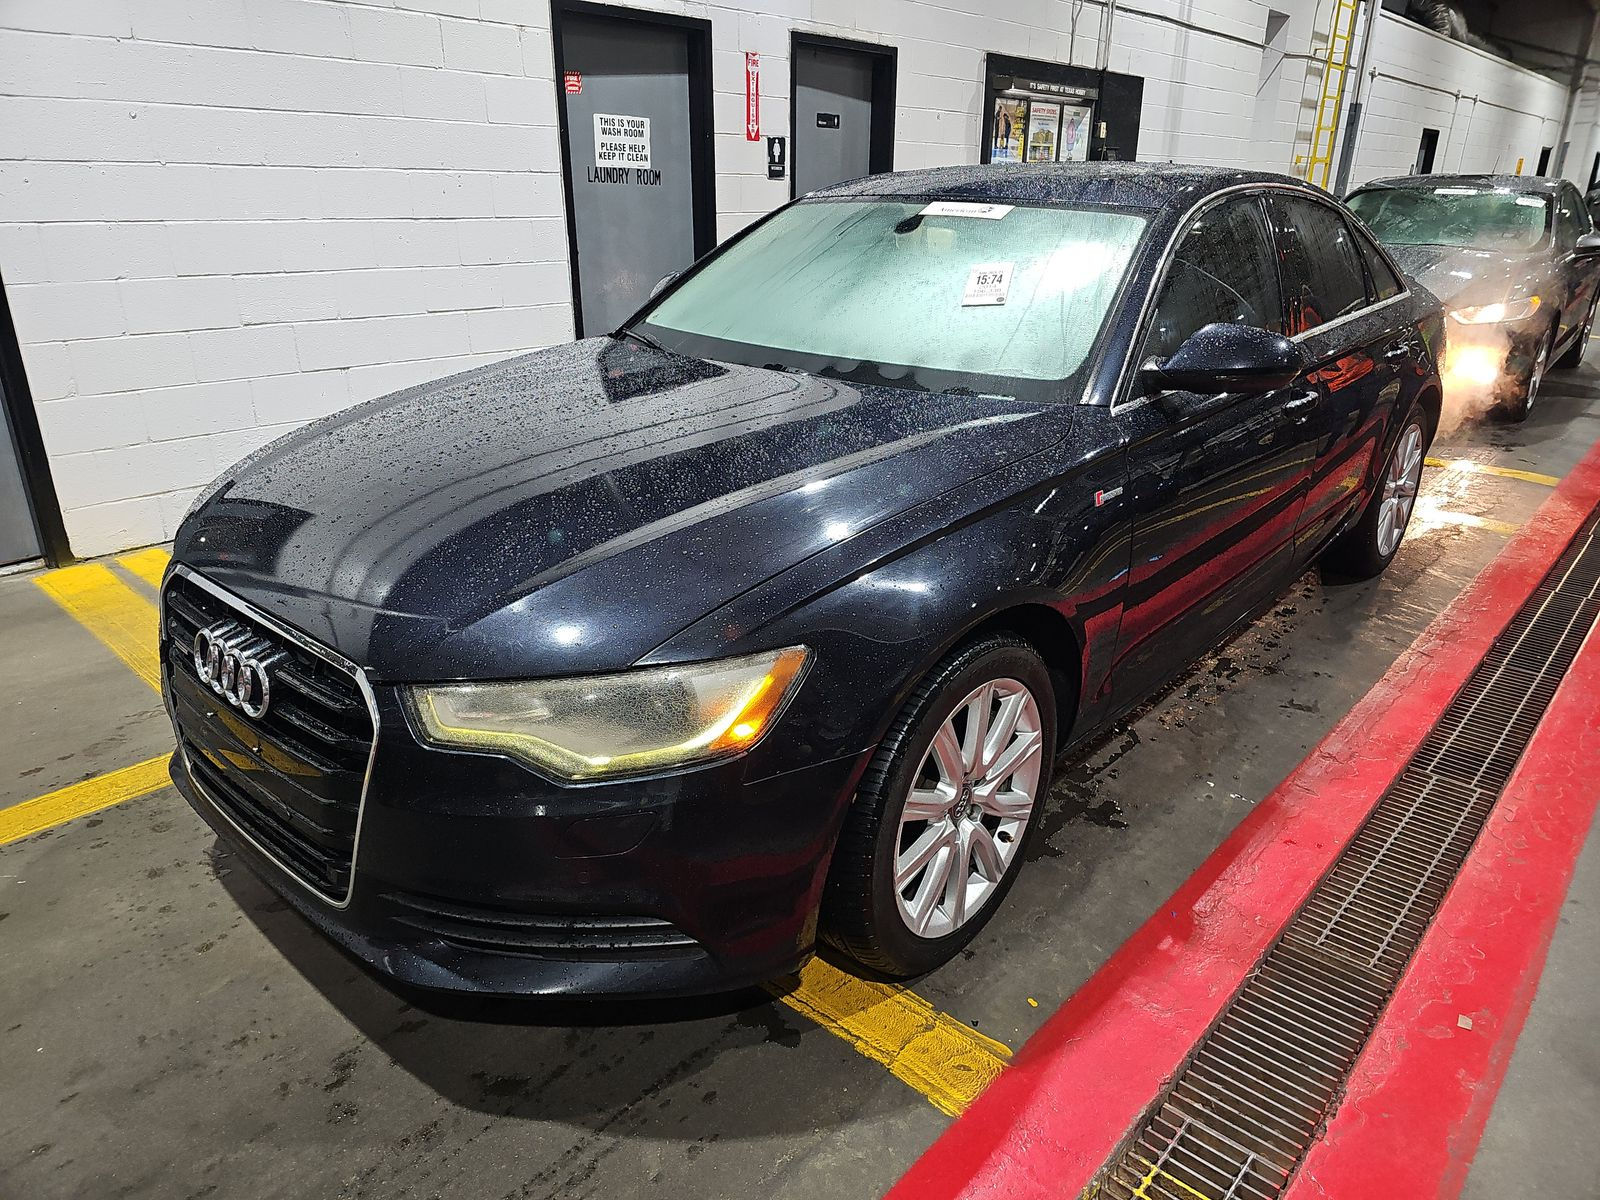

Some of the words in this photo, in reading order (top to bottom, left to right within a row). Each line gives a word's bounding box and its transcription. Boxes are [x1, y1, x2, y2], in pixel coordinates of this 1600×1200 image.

[749, 58, 759, 67] FIRE
[1037, 83, 1050, 92] SAFETY
[1050, 84, 1060, 92] FIRST
[1065, 87, 1075, 95] TEXAS
[1032, 106, 1046, 114] SAFETY
[600, 117, 616, 127] THIS
[618, 118, 625, 128] IS
[627, 119, 645, 129] YOUR
[601, 127, 622, 137] WASH
[624, 128, 645, 138] ROOM
[601, 142, 627, 152] PLEASE
[629, 144, 646, 153] HELP
[598, 151, 617, 160] KEEP
[619, 152, 625, 161] IT
[627, 153, 649, 162] CLEAN
[587, 166, 630, 184] LAUNDRY
[637, 168, 661, 186] ROOM
[976, 274, 1003, 285] 15:74
